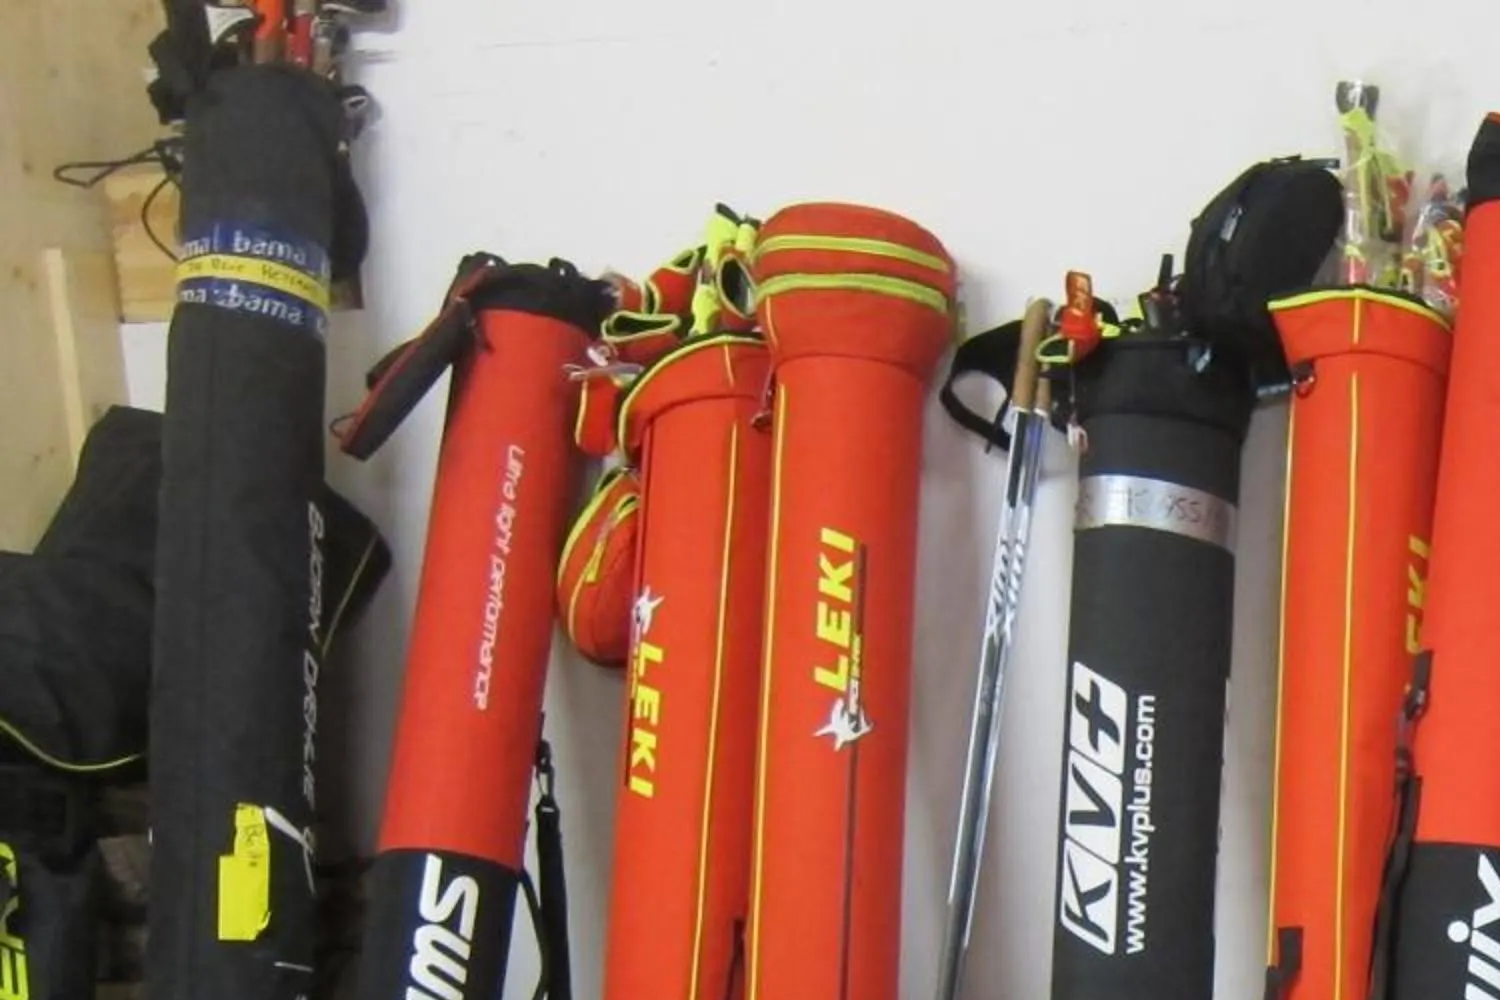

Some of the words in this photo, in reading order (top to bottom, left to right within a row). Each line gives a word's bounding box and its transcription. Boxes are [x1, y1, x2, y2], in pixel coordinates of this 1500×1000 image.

[224, 283, 304, 325] bama
[233, 229, 307, 266] bama
[813, 527, 855, 692] LEKI
[1405, 533, 1432, 658] EKI
[629, 641, 664, 798] LEKI
[1124, 694, 1156, 955] www.kvplus.com
